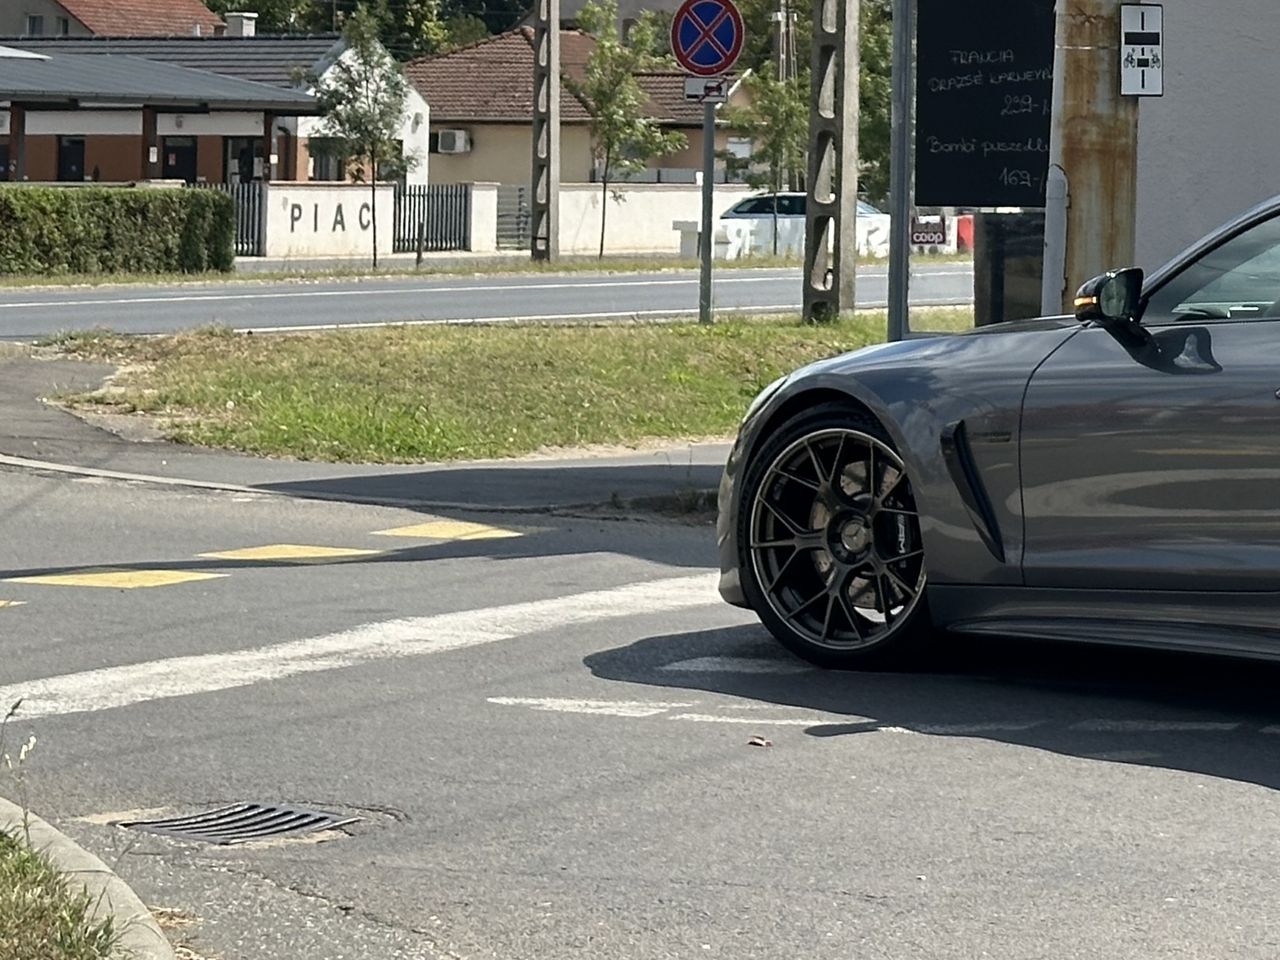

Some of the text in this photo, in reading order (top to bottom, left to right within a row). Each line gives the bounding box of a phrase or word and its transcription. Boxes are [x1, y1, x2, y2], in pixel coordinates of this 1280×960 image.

[949, 48, 1014, 65] FRANCIA
[925, 135, 976, 153] Bambi
[290, 202, 371, 233] PIAC
[913, 232, 943, 245] coop
